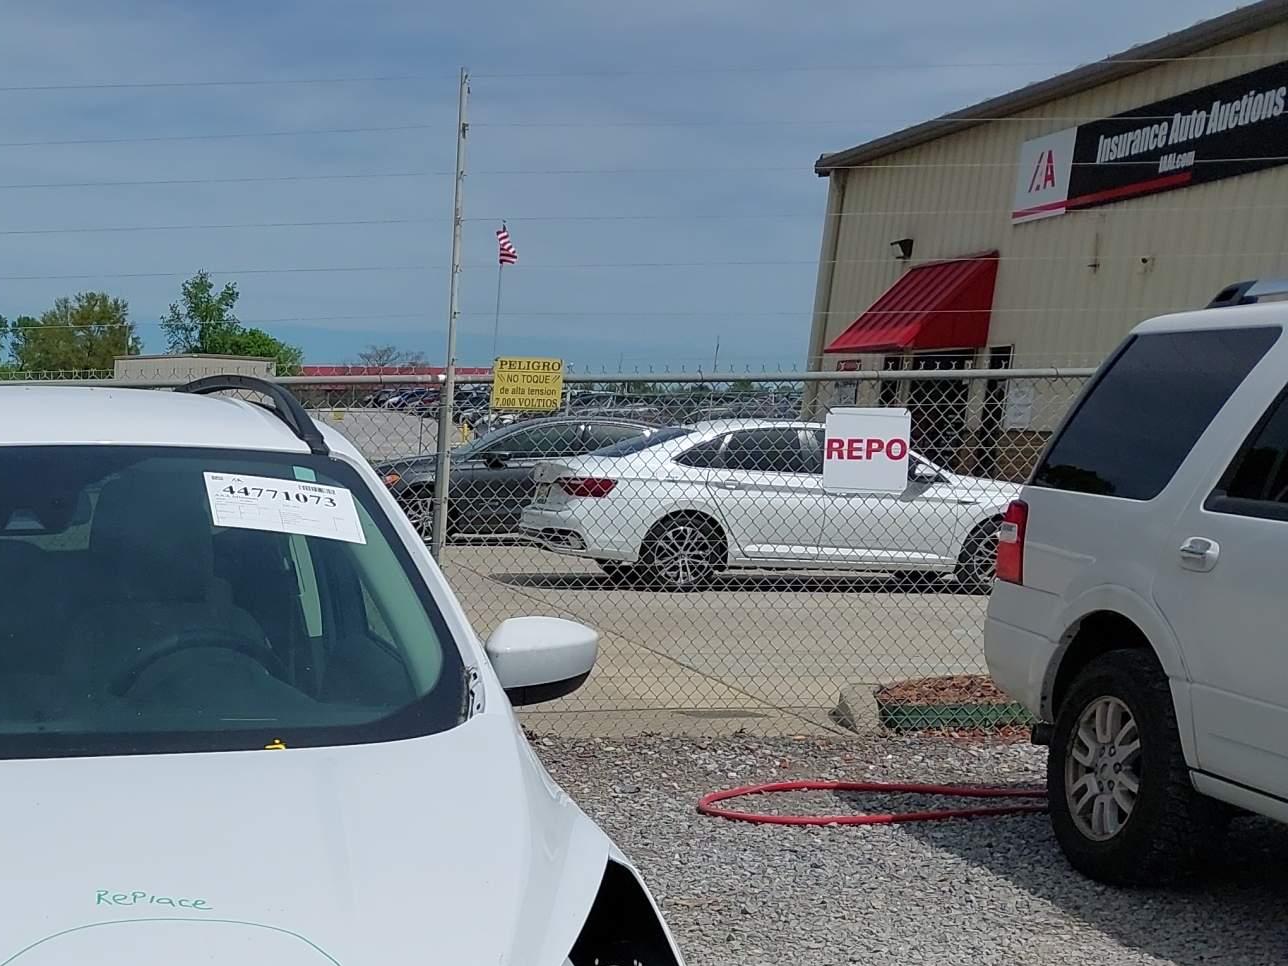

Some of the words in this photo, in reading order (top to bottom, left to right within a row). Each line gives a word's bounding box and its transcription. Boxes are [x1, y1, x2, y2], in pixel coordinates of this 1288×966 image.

[1096, 122, 1169, 164] Insurance
[1168, 109, 1207, 146] Auto
[1206, 86, 1287, 135] Auctions
[498, 360, 561, 371] PELIGRO
[506, 374, 519, 383] NO
[522, 374, 551, 384] TOQUE
[499, 386, 510, 395] de
[511, 386, 526, 395] alta
[527, 386, 557, 396] tension
[518, 398, 558, 408] VOLTIOS
[826, 438, 908, 461] REPO
[222, 485, 337, 508] 44771073
